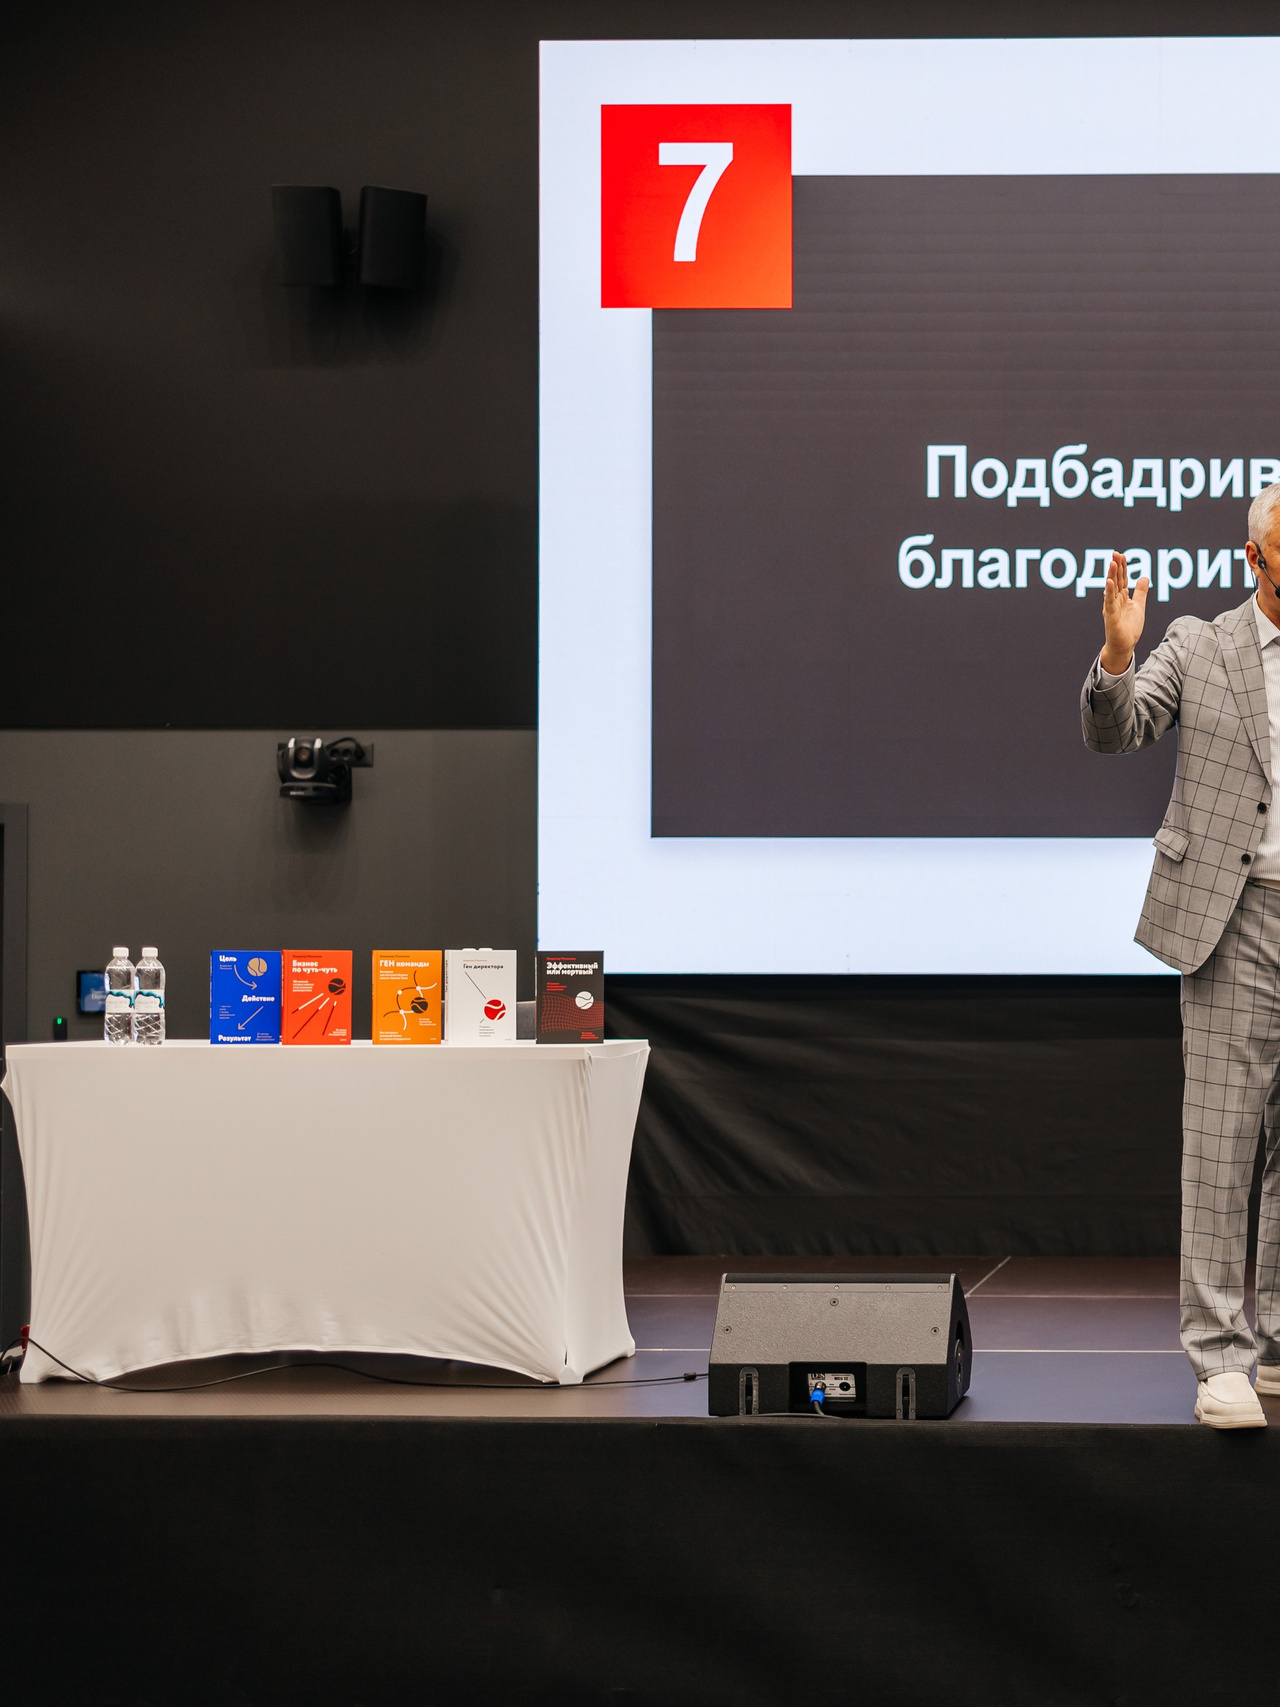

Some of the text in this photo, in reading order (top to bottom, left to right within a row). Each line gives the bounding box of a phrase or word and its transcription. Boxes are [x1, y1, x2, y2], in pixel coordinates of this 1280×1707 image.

[658, 142, 734, 262] 7
[898, 533, 1259, 602] благодарит
[292, 959, 318, 967] Бизнес
[546, 961, 598, 970] Эффективный
[241, 994, 275, 1002] Действие
[218, 1034, 252, 1043] Результат
